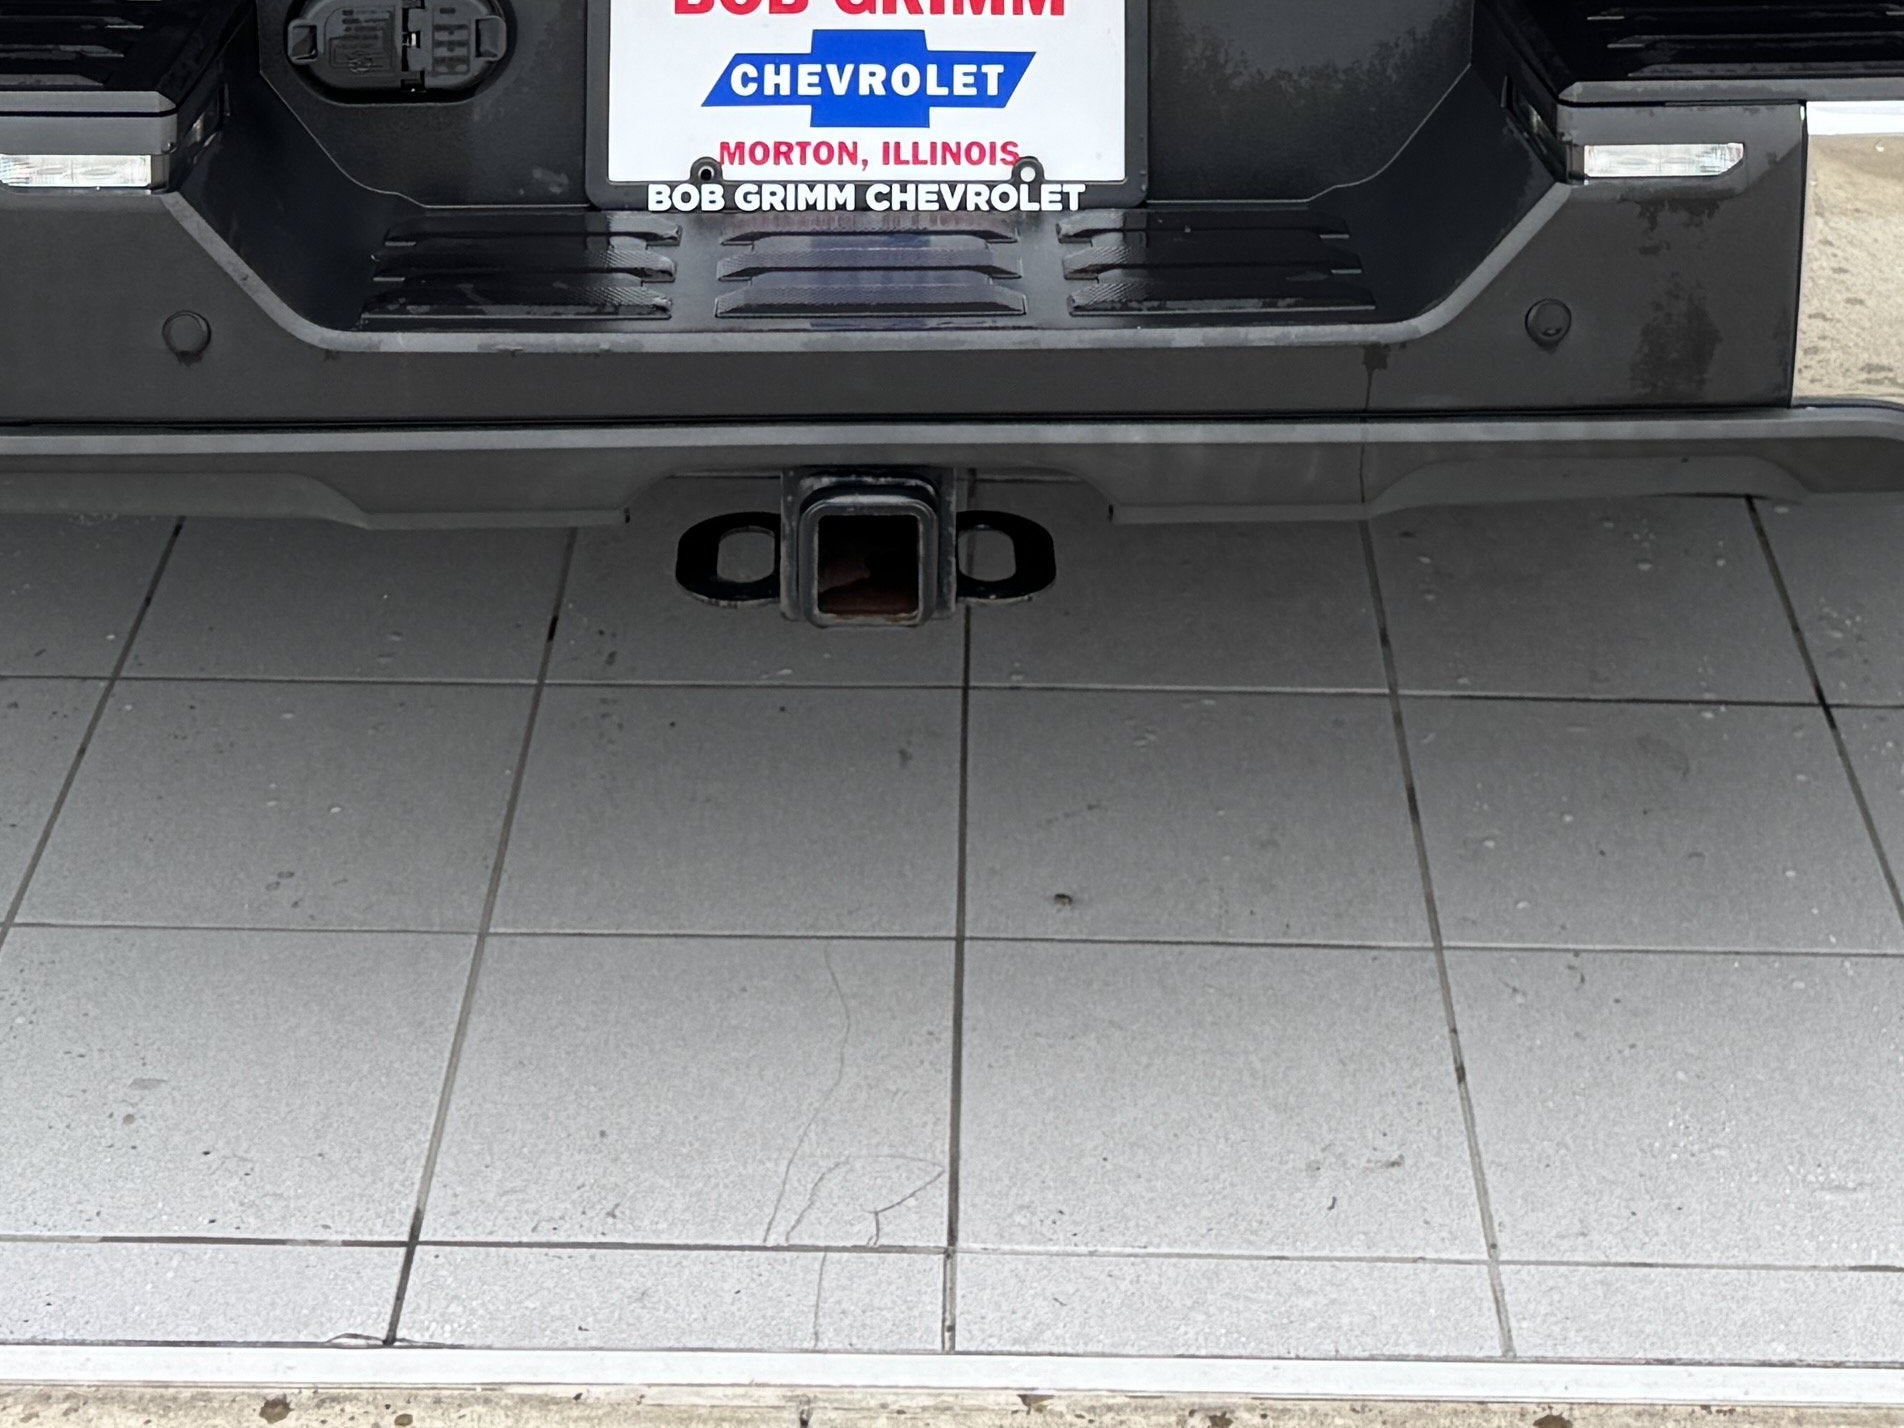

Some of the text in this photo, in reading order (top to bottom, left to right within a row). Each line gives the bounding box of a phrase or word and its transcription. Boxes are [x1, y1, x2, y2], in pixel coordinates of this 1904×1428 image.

[729, 61, 1005, 97] CHEVROLET
[718, 140, 1020, 171] MORTON, ILLINOIS
[646, 182, 1086, 213] BOB GRIMM CHEVROLET
